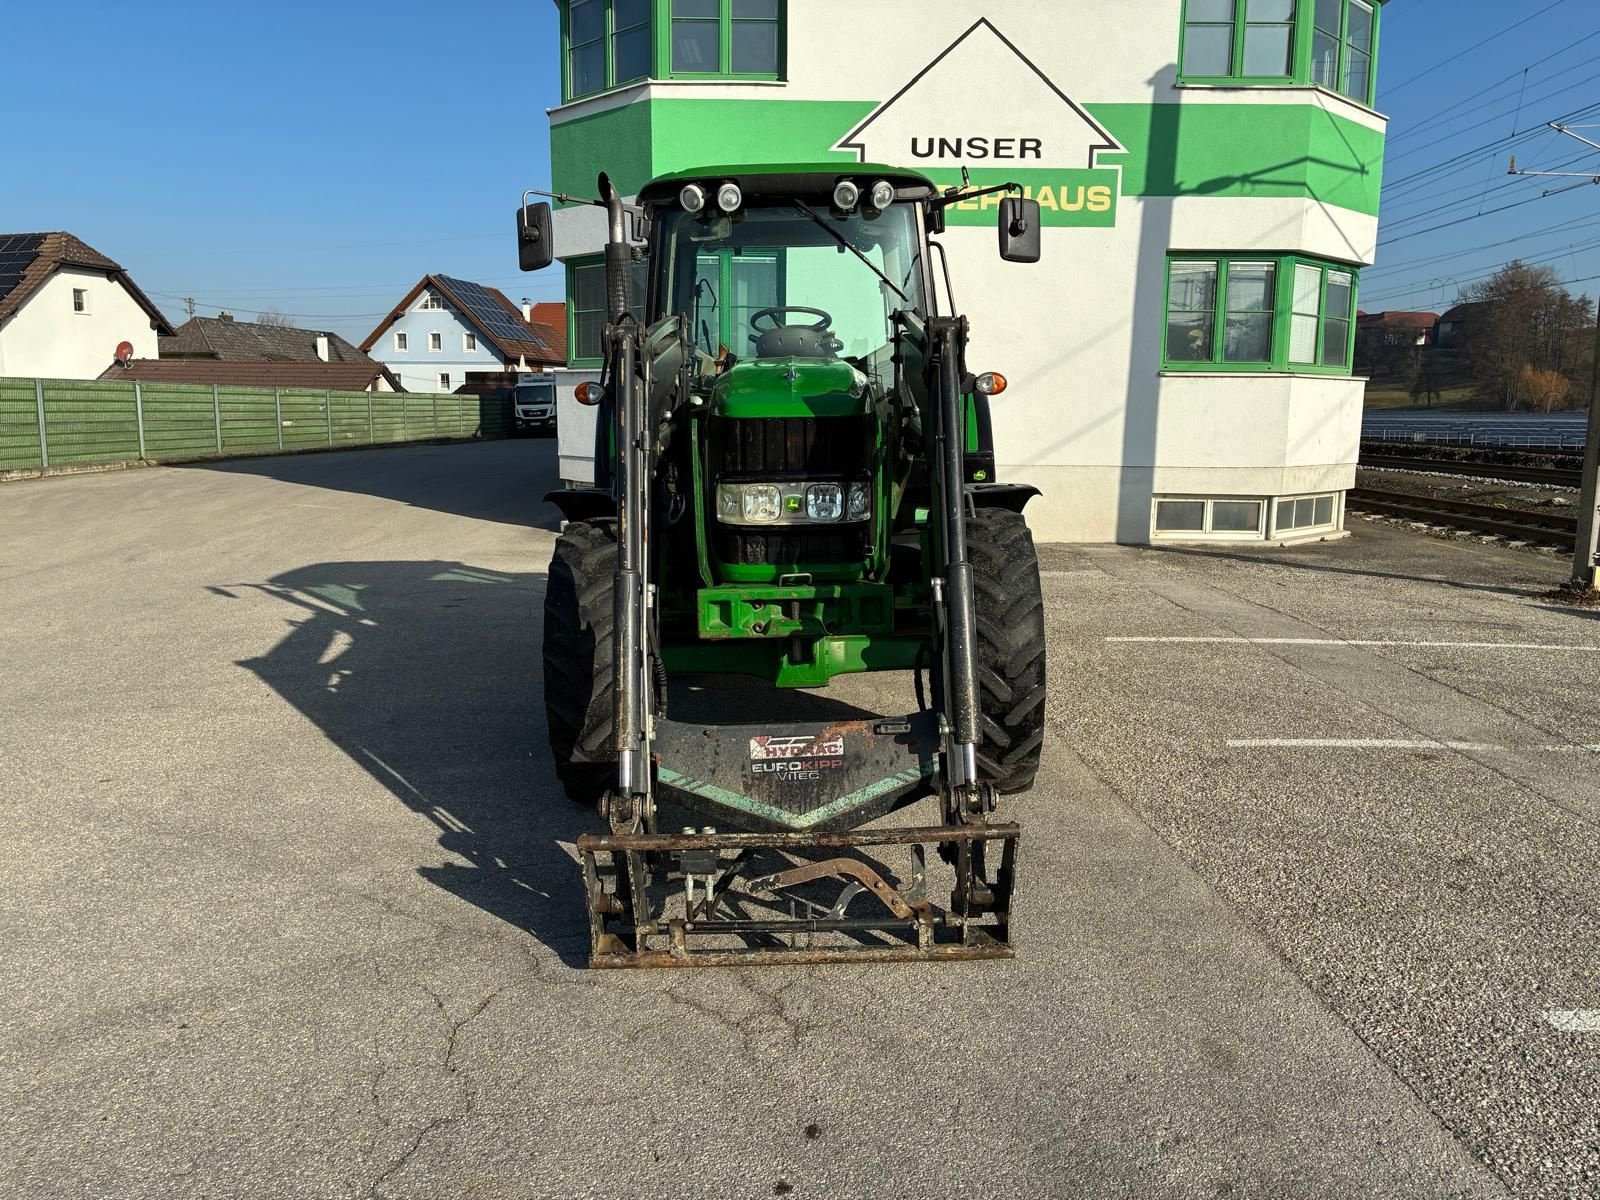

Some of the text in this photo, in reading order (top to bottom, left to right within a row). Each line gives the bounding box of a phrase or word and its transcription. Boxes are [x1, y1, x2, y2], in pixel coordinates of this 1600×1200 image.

[911, 137, 1042, 159] UNSER
[765, 744, 839, 757] HYDRAC
[752, 760, 842, 773] EUROKIPP
